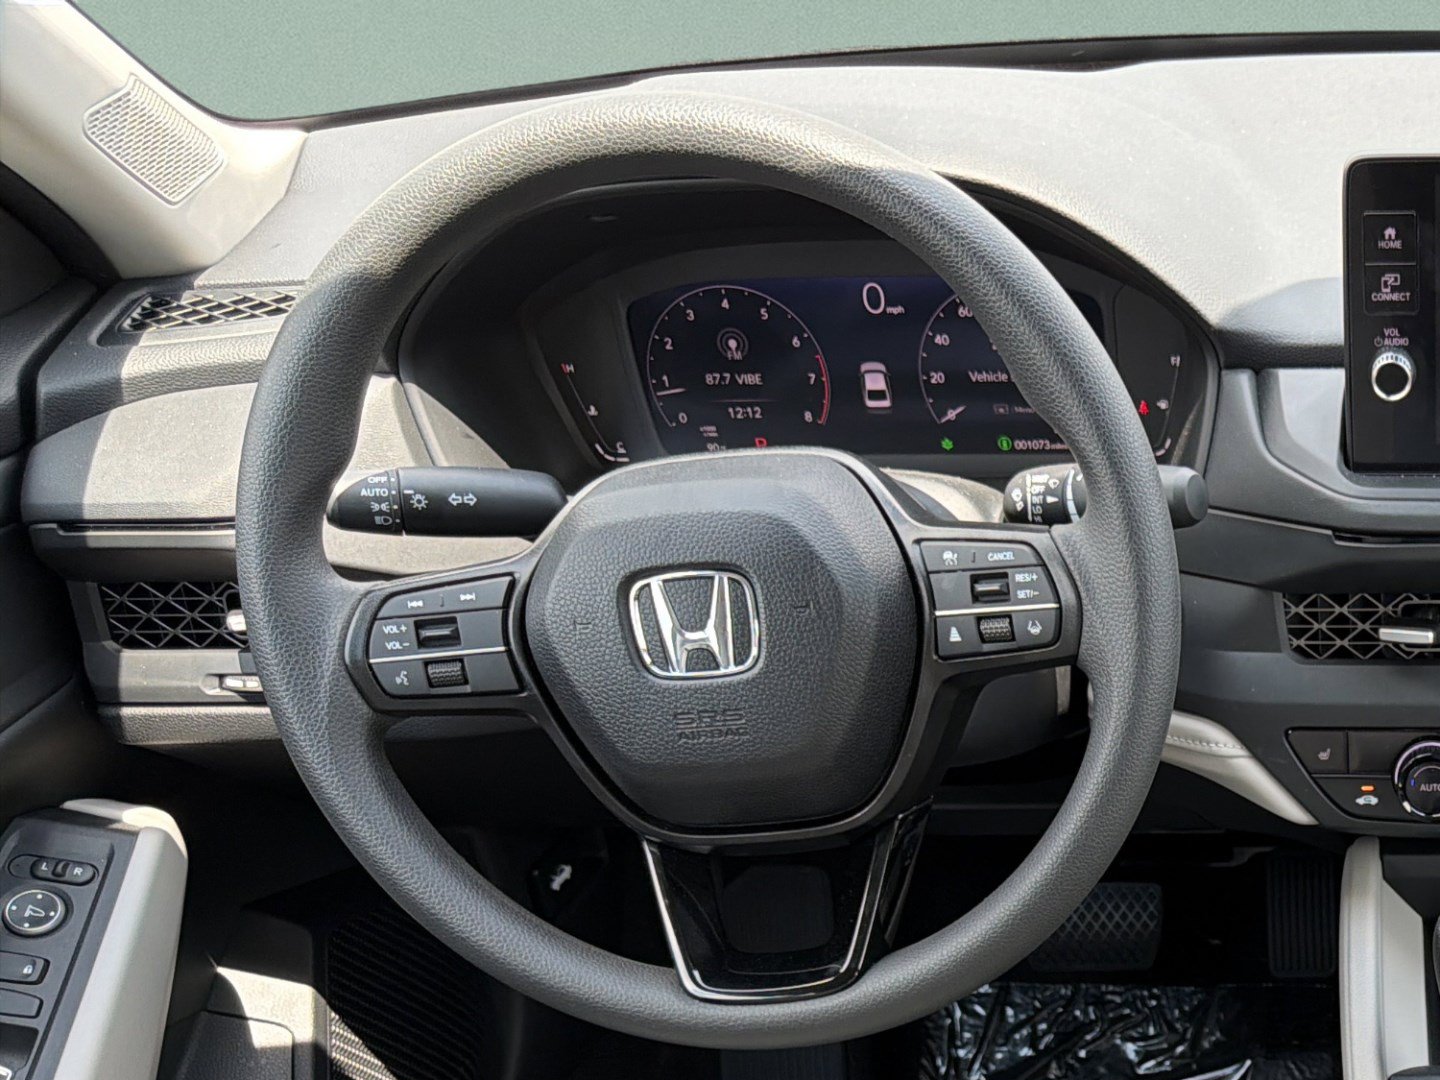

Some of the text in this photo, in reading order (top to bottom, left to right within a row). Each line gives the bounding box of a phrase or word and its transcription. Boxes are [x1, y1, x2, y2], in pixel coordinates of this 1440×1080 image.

[1378, 241, 1402, 249] HOME
[862, 282, 905, 317] 0 mph
[1372, 293, 1411, 302] CONNECT
[721, 298, 730, 310] 4
[686, 310, 695, 321] 3
[761, 309, 769, 320] 5
[1384, 328, 1400, 337] VOL
[664, 338, 673, 350] 2
[792, 337, 801, 348] 6
[934, 334, 950, 347] 40
[1384, 338, 1409, 346] AUDIO
[728, 351, 742, 361] FM
[663, 375, 669, 387] 1
[705, 373, 763, 385] 87.7 VIBE
[808, 373, 815, 385] 7
[930, 372, 945, 385] 20
[968, 371, 1009, 384] Vehicle
[678, 412, 688, 424] 0
[728, 407, 762, 419] 12:12
[804, 411, 813, 423] 8
[1014, 440, 1050, 451] 001073
[367, 476, 387, 484] OFF
[361, 487, 389, 497] AUTO
[988, 552, 1015, 561] CANCEL
[41, 863, 83, 876] L R
